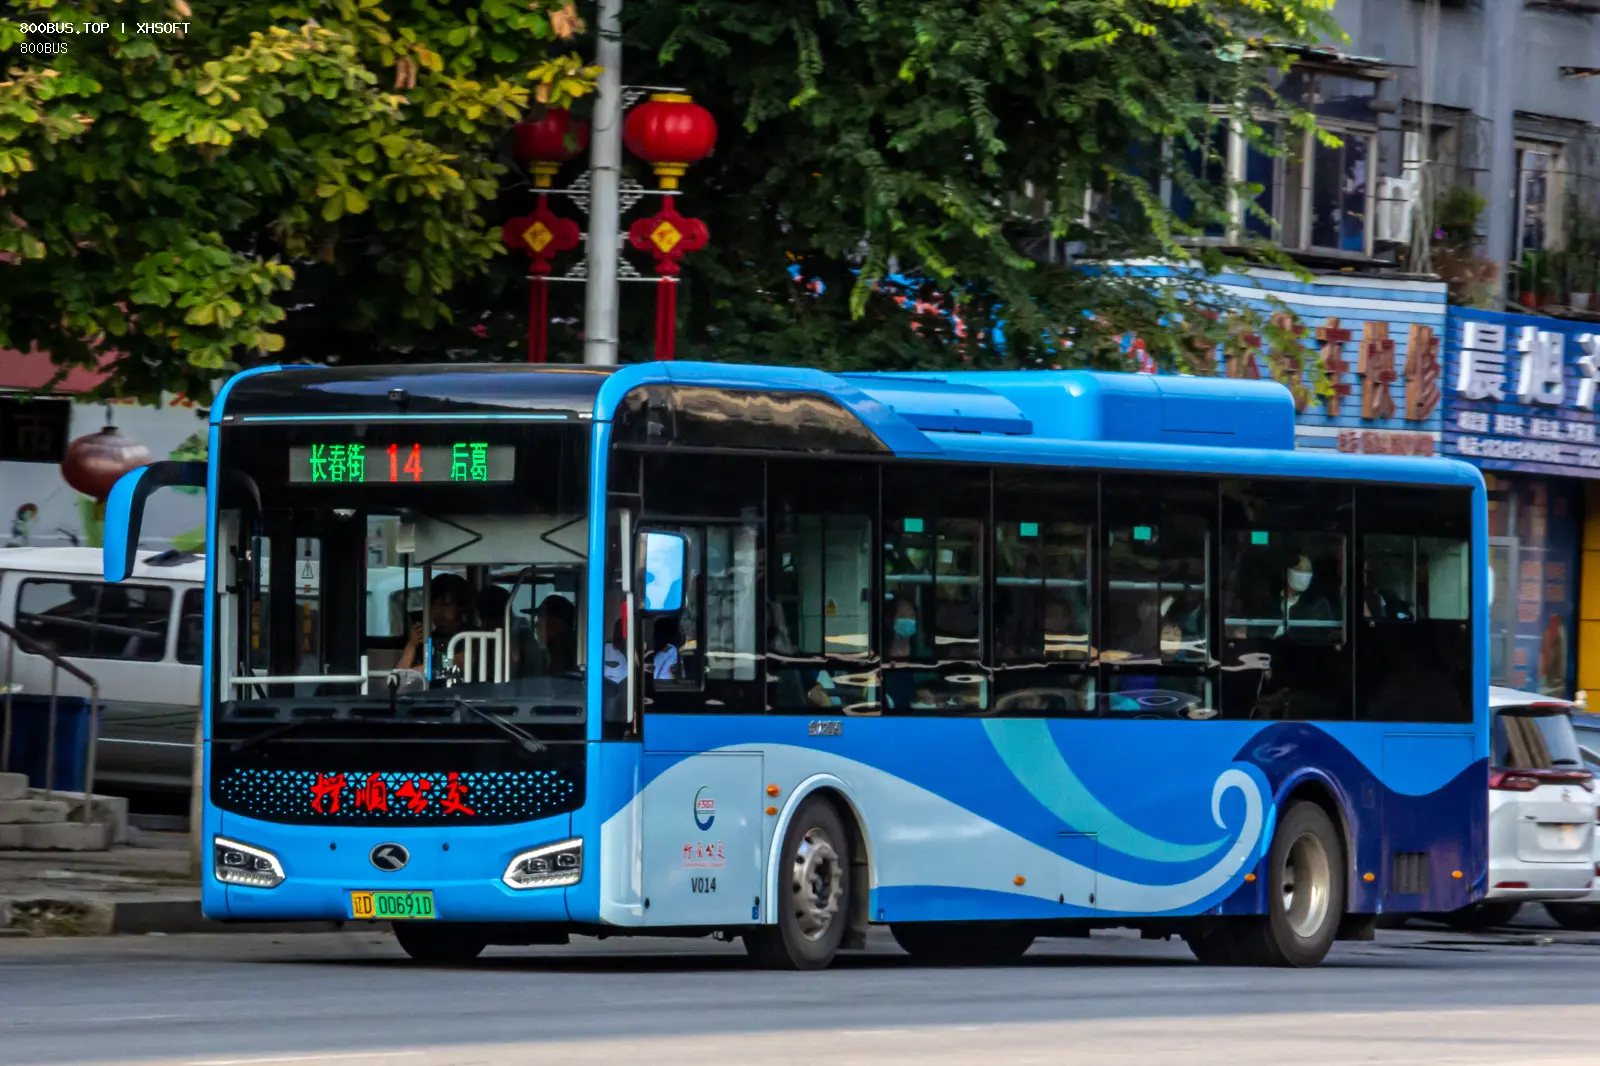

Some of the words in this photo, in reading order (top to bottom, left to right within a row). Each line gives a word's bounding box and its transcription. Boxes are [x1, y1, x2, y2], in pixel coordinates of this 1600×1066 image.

[309, 443, 366, 482] 长春街
[386, 443, 423, 482] 14
[310, 772, 476, 816] 抚顺公交
[691, 877, 717, 894] V014
